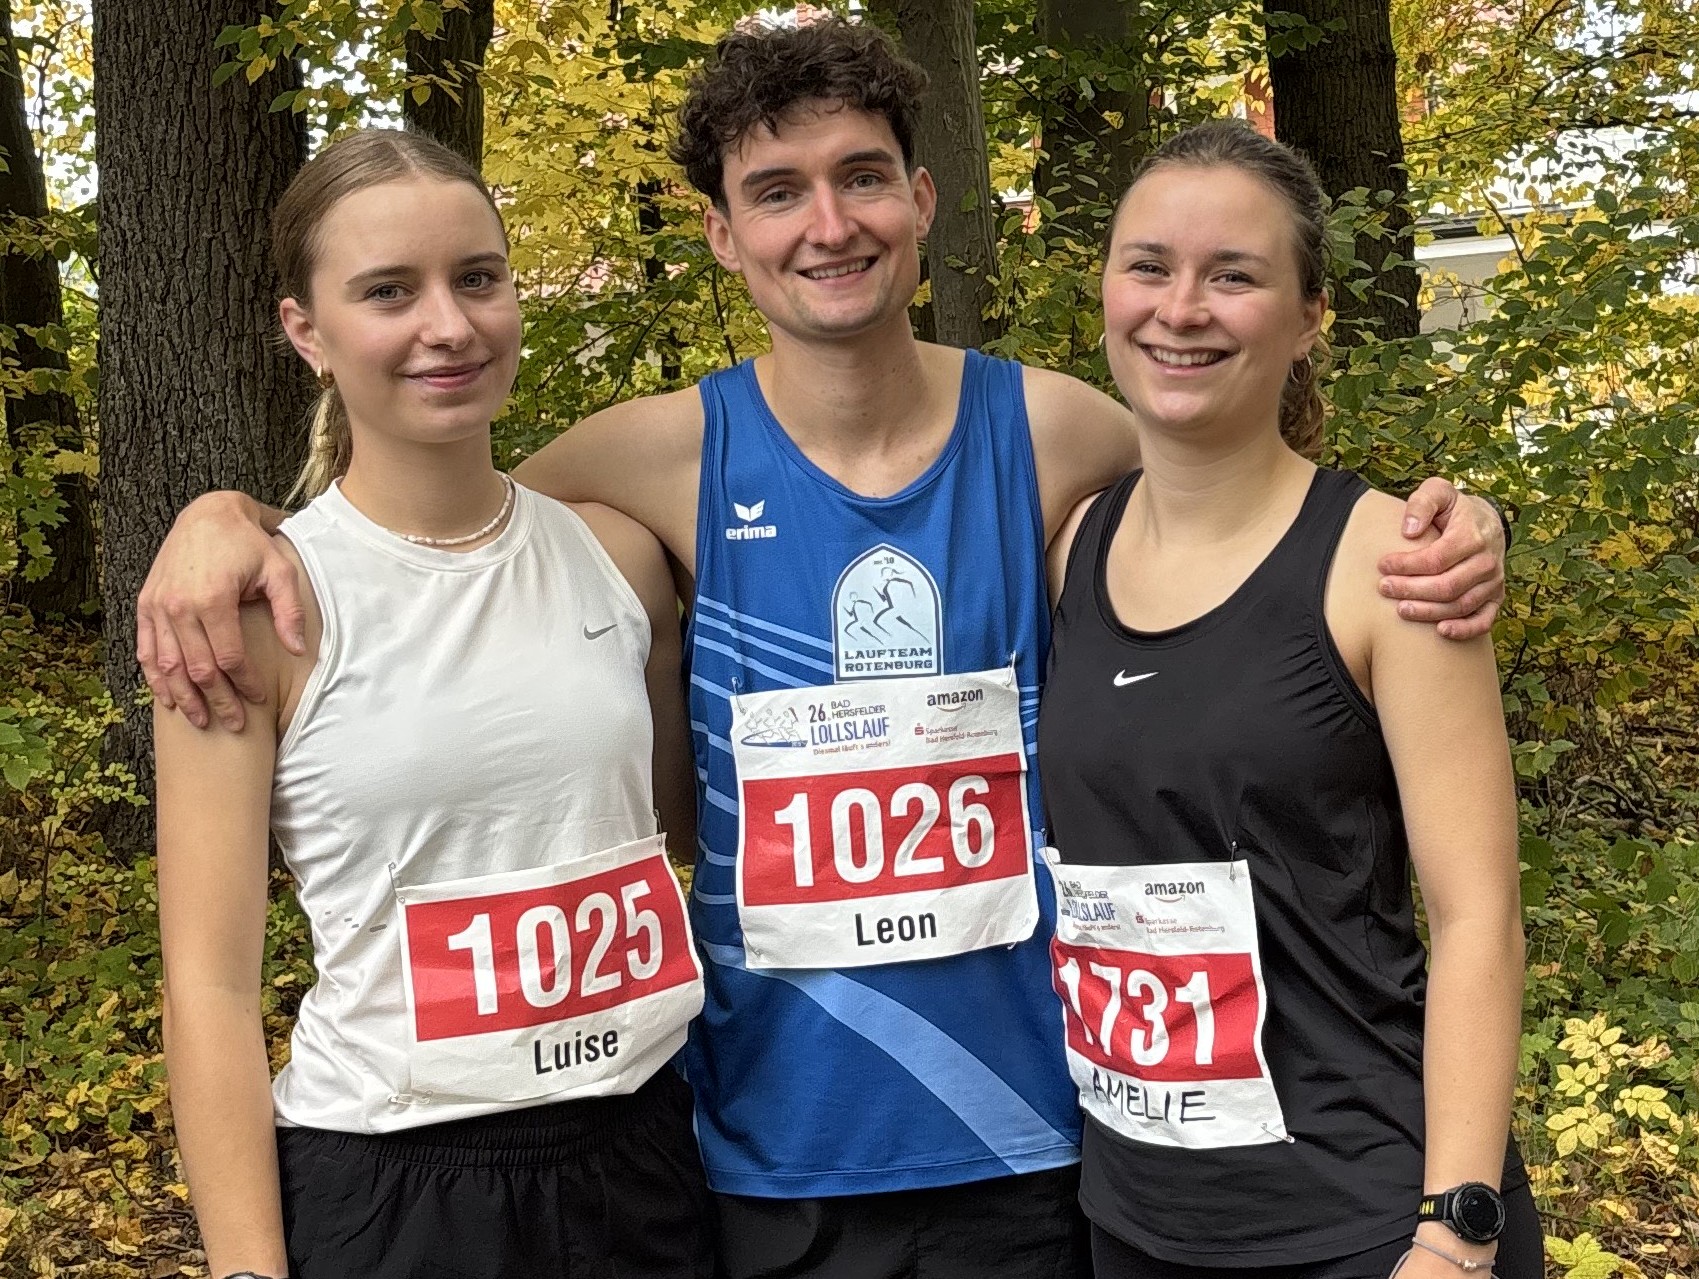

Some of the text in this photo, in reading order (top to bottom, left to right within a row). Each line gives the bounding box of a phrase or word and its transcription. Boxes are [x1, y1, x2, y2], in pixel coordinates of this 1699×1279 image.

[725, 524, 777, 540] erima
[844, 647, 933, 660] LAUFTEAM
[844, 659, 933, 673] ROTENBURG
[831, 700, 850, 709] BAD
[927, 688, 984, 707] amazon
[831, 705, 886, 719] HERSFELDER
[810, 717, 891, 746] LOLLSLAUF
[774, 775, 995, 887] 1026
[1144, 881, 1205, 896] amazon
[855, 912, 938, 947] Leon
[447, 879, 663, 1016] 1025
[1057, 957, 1216, 1066] 1731
[534, 1029, 619, 1075] Luise
[1092, 1066, 1216, 1125] AMELIE
